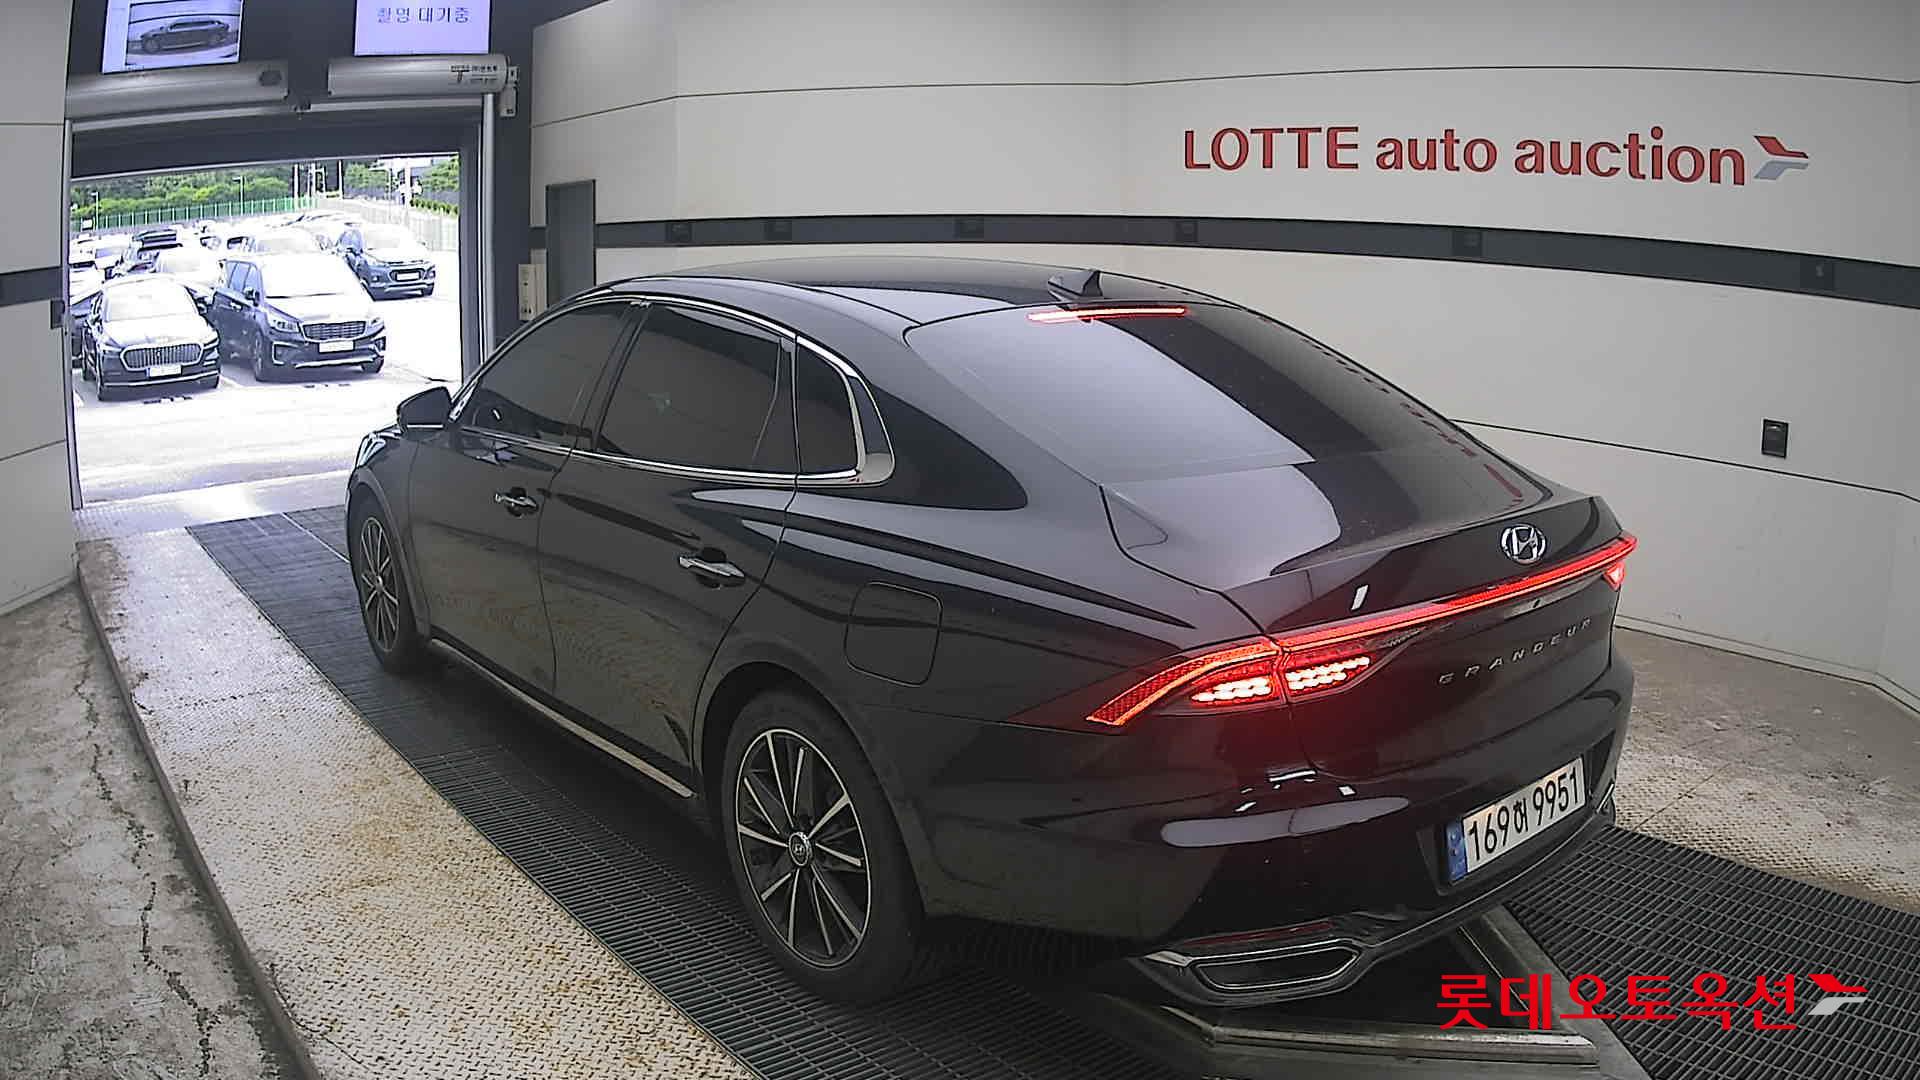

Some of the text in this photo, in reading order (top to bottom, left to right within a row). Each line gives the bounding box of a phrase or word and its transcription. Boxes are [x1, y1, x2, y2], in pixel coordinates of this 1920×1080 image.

[418, 7, 469, 23] 대기중
[1184, 126, 1747, 186] LOTTE auto auction
[1438, 617, 1592, 684] GRANDEUR
